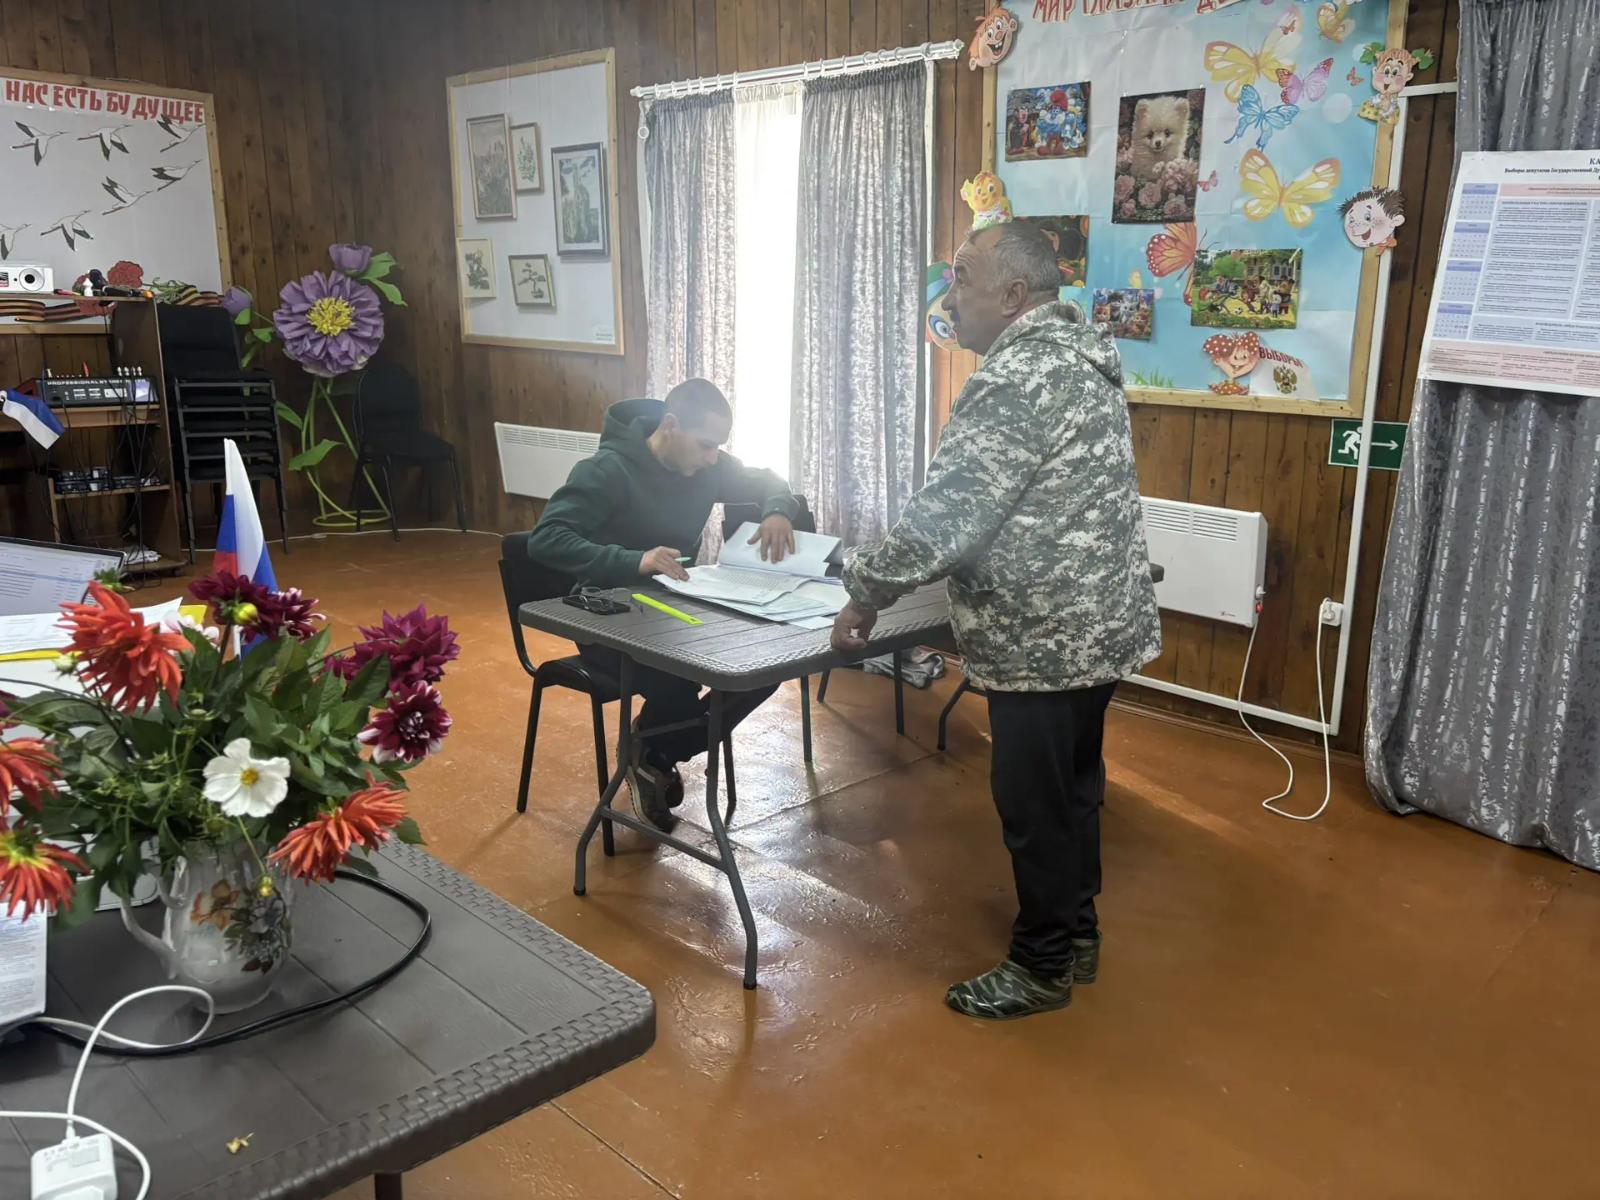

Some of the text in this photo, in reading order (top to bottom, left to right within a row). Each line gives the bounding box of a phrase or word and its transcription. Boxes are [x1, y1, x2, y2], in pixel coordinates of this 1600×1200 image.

[1032, 0, 1073, 22] МИР
[6, 80, 48, 106] НАС
[53, 86, 102, 112] ЕСТЬ
[1259, 346, 1304, 368] ВЫБОРЫ
